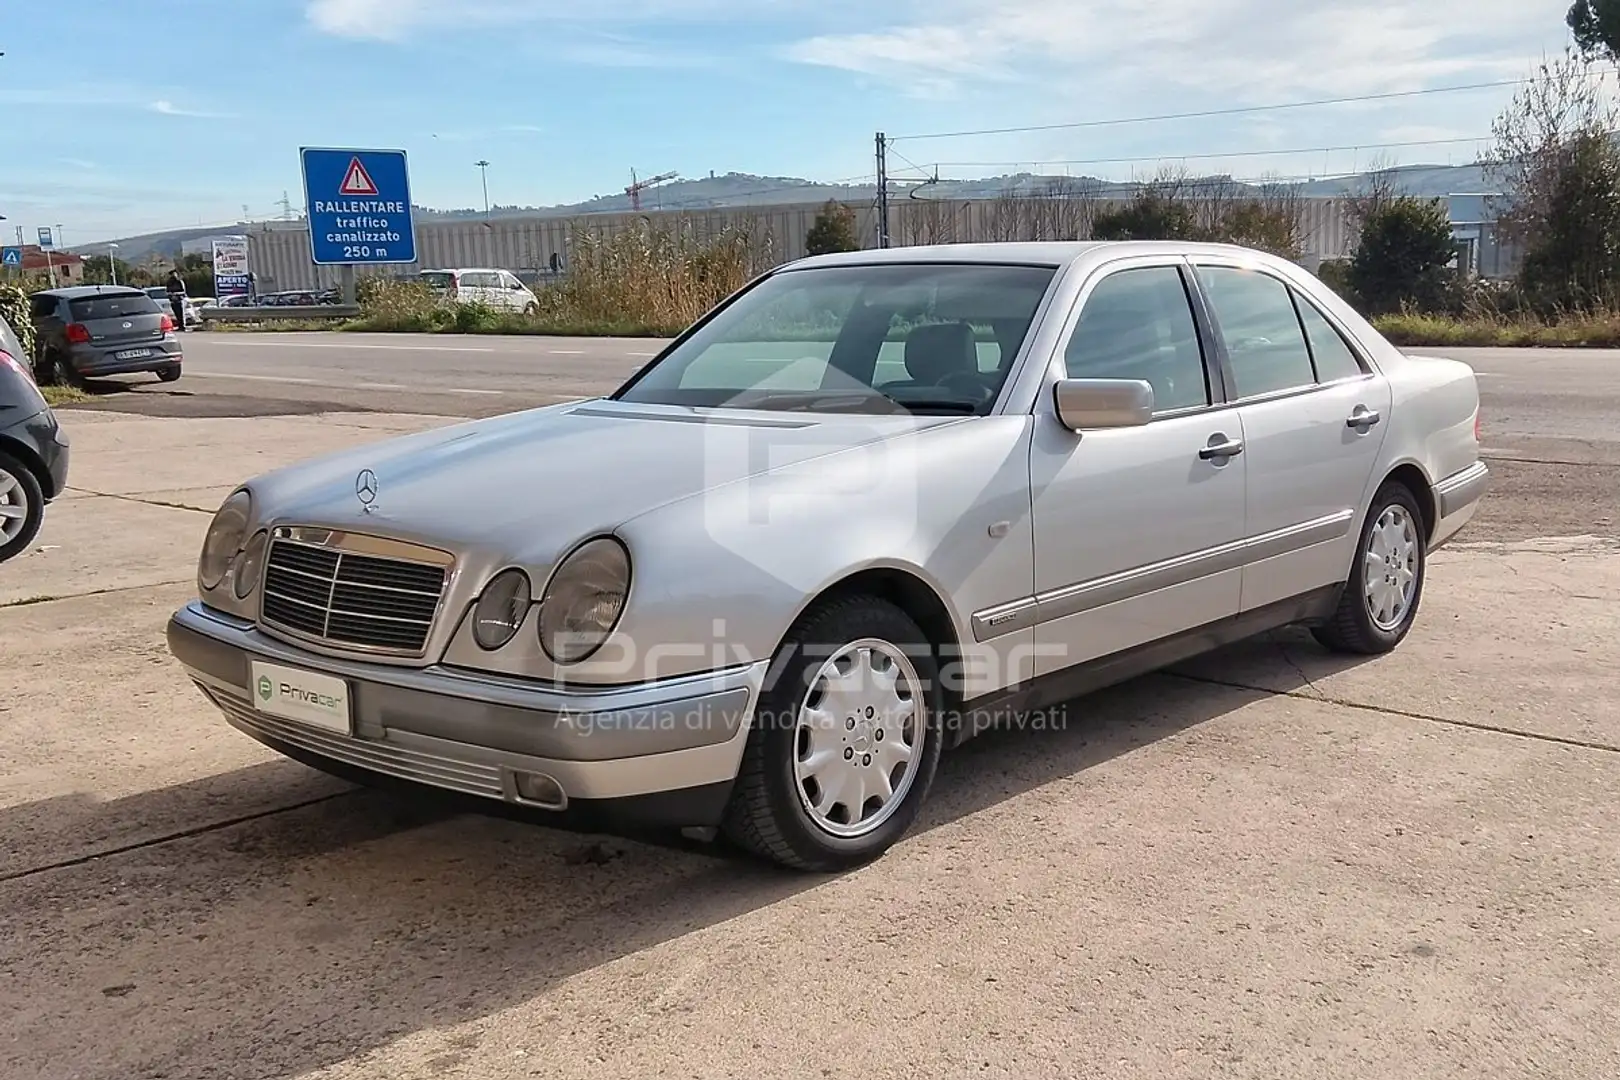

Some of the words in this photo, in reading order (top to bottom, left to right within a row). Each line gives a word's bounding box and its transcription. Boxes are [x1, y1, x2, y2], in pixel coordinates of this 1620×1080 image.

[315, 201, 405, 213] RALLENTARE
[336, 216, 388, 228] traffico
[326, 231, 400, 242] canalizzato
[344, 245, 370, 258] 250
[375, 247, 388, 257] m
[217, 276, 248, 284] APERTO
[280, 682, 342, 709] Privacar
